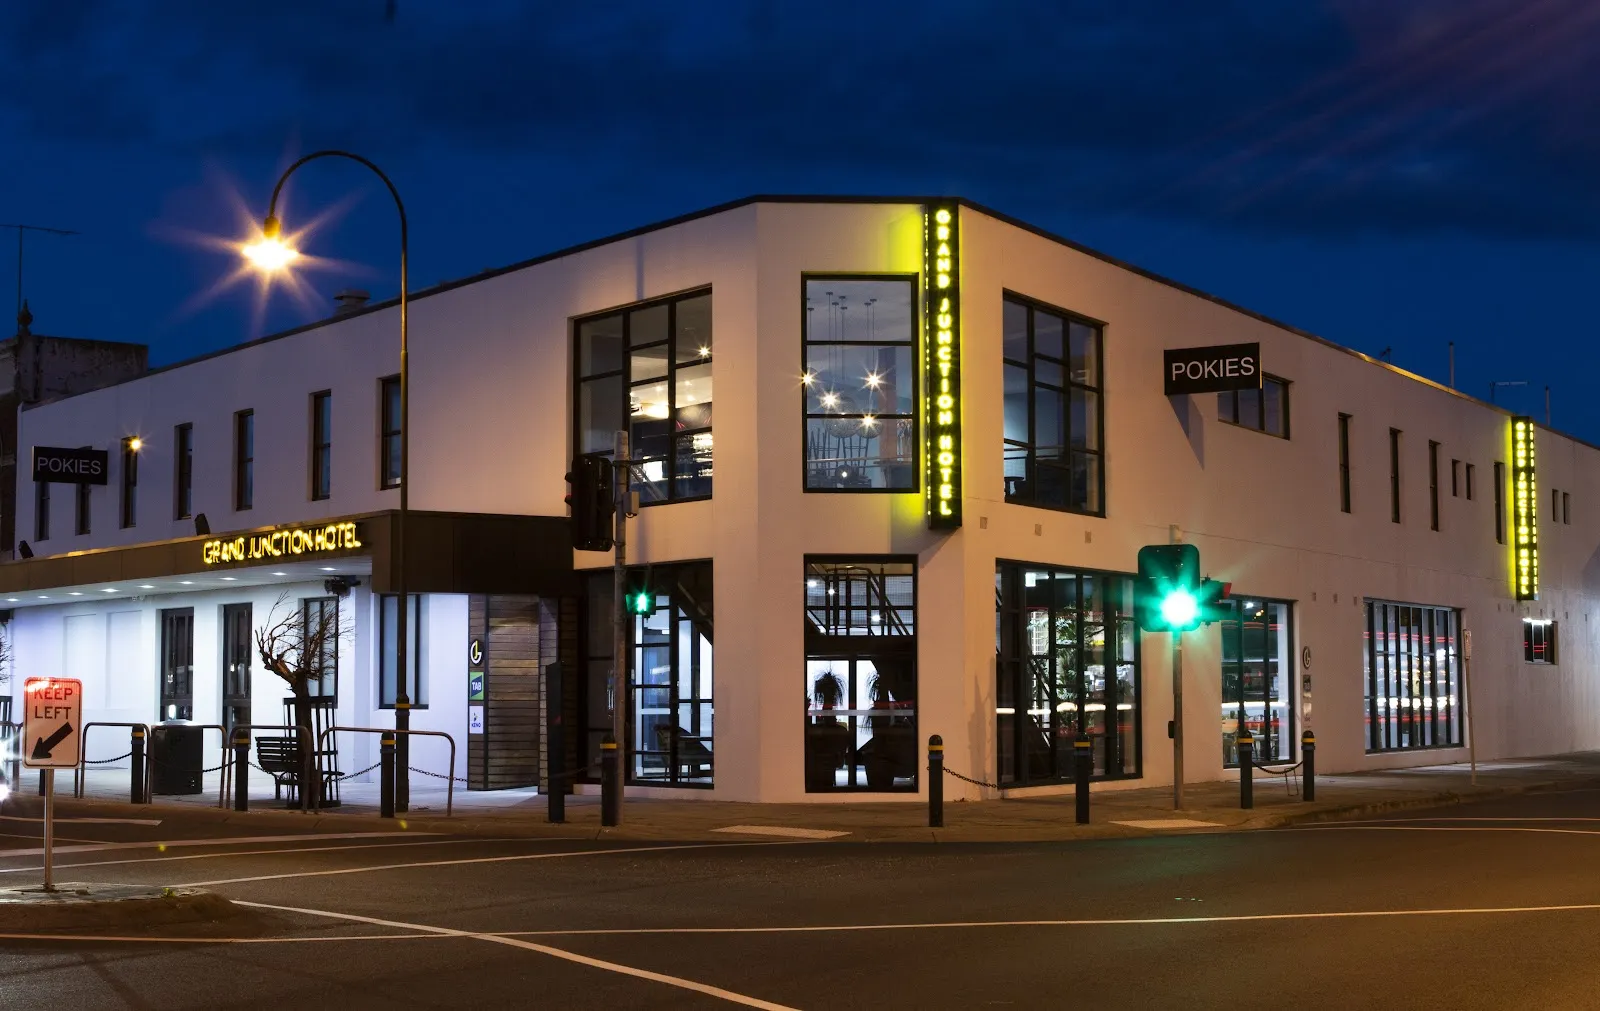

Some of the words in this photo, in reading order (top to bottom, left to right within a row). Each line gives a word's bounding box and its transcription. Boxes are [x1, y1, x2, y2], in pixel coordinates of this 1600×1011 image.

[936, 209, 951, 289] GRAND
[937, 297, 953, 426] JUNCTION
[1171, 356, 1255, 381] POKIES
[37, 456, 101, 475] POKIES
[938, 435, 953, 515] HOTEL
[203, 537, 245, 564] GRAND
[247, 529, 314, 559] JUNCTION
[315, 522, 362, 551] HOTEL
[34, 687, 73, 701] KEEP
[471, 681, 482, 691] TAB
[34, 705, 72, 720] LEFT
